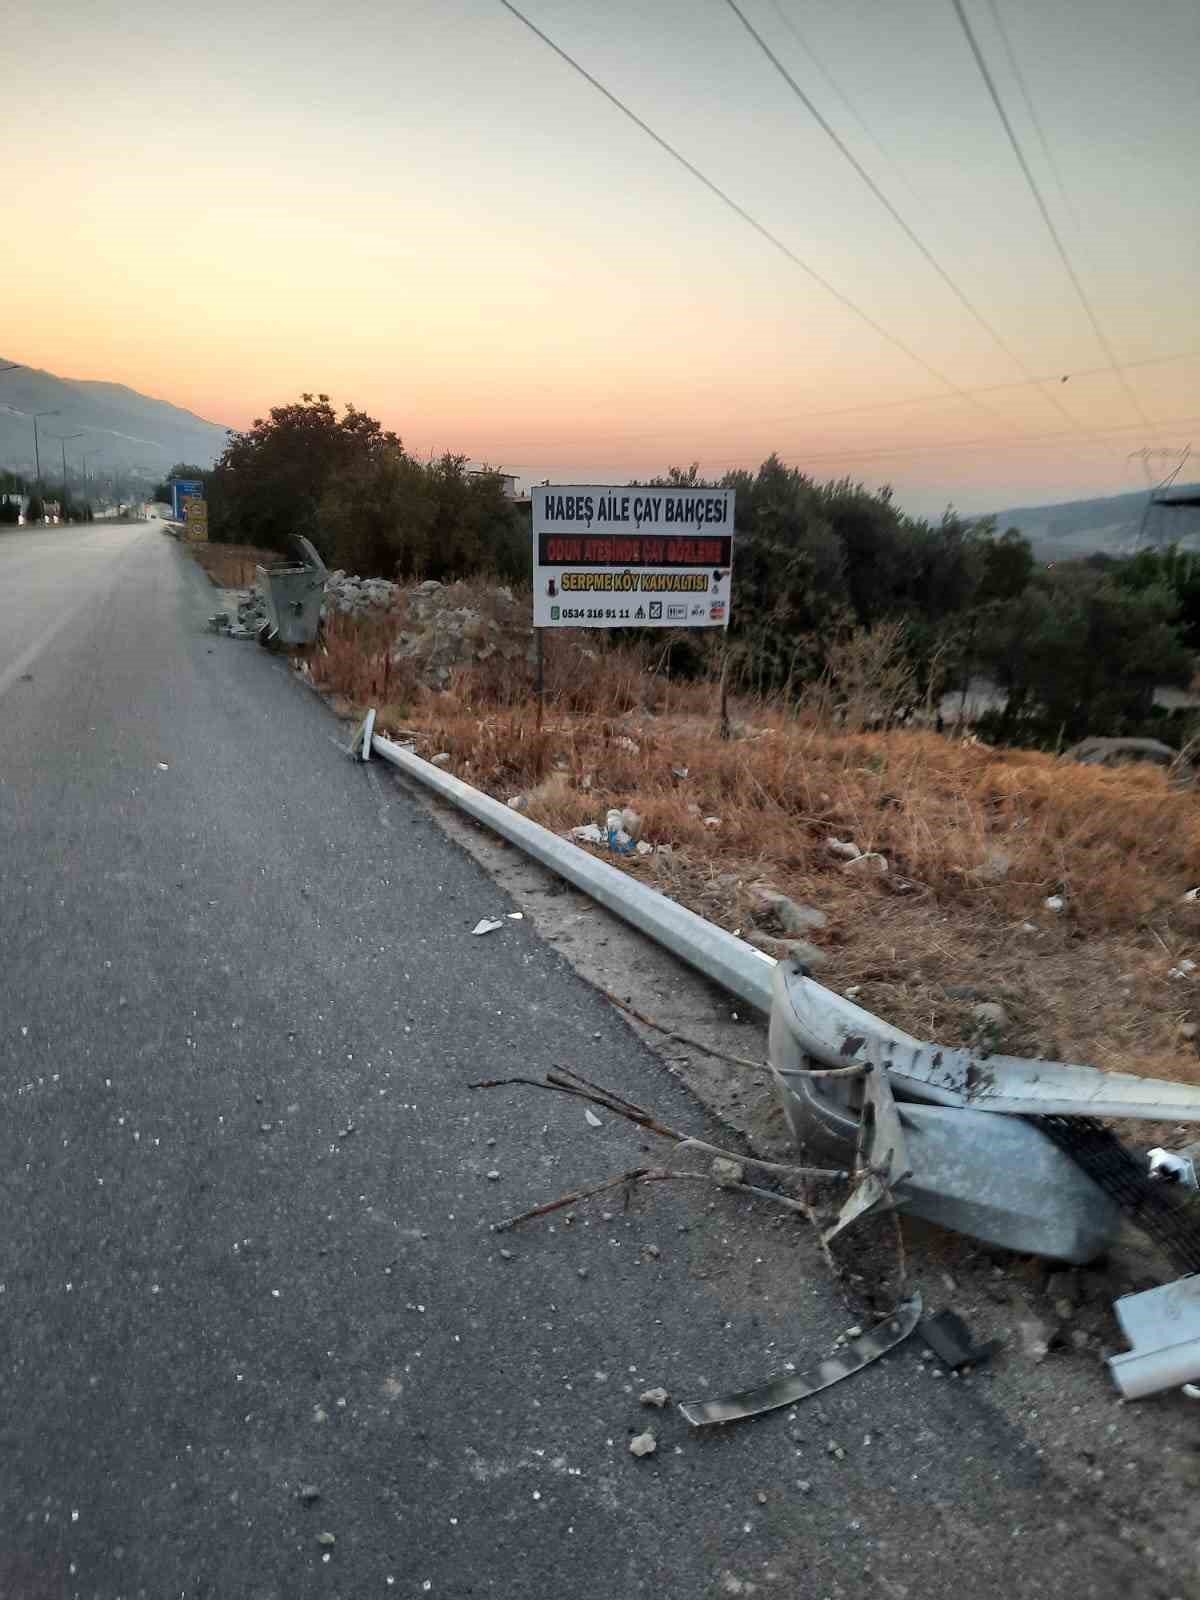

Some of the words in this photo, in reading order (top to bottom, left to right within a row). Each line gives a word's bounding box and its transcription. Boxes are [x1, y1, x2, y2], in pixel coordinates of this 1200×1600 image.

[545, 496, 593, 527] HABEŞ
[597, 491, 630, 522] AİLE
[633, 497, 663, 528] ÇAY
[665, 492, 727, 530] BAHÇESİ
[561, 573, 613, 591] SERPME
[614, 570, 640, 591] KÖY
[641, 574, 708, 592] KAHVALTISI
[562, 608, 585, 618] 0534
[605, 608, 617, 618] 91
[619, 608, 630, 618] 11
